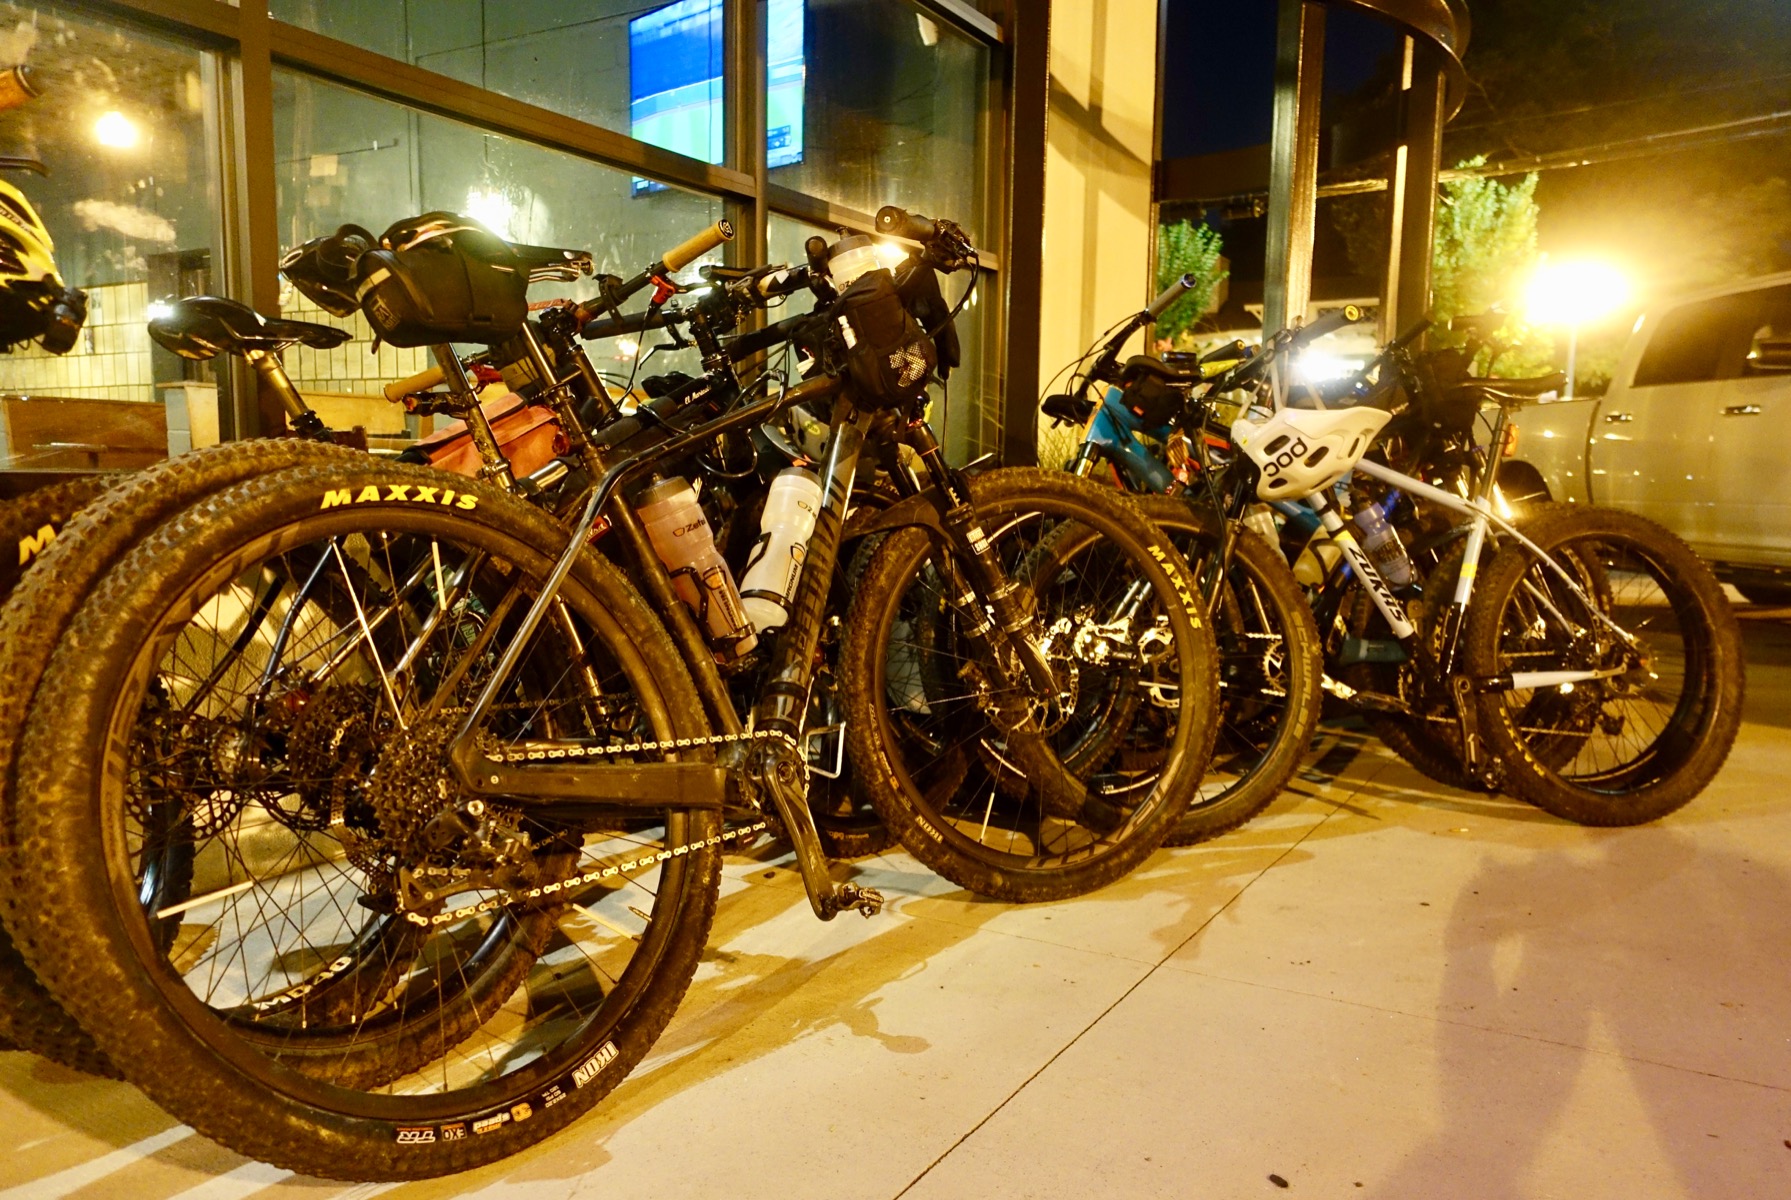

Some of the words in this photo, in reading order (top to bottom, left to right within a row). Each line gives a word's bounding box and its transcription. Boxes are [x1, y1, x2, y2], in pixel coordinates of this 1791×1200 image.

[320, 484, 479, 510] MAXXIS
[1147, 545, 1202, 629] MAXXIS
[914, 814, 944, 844] IKON
[572, 1040, 620, 1088] IKON
[396, 1130, 436, 1144] TR
